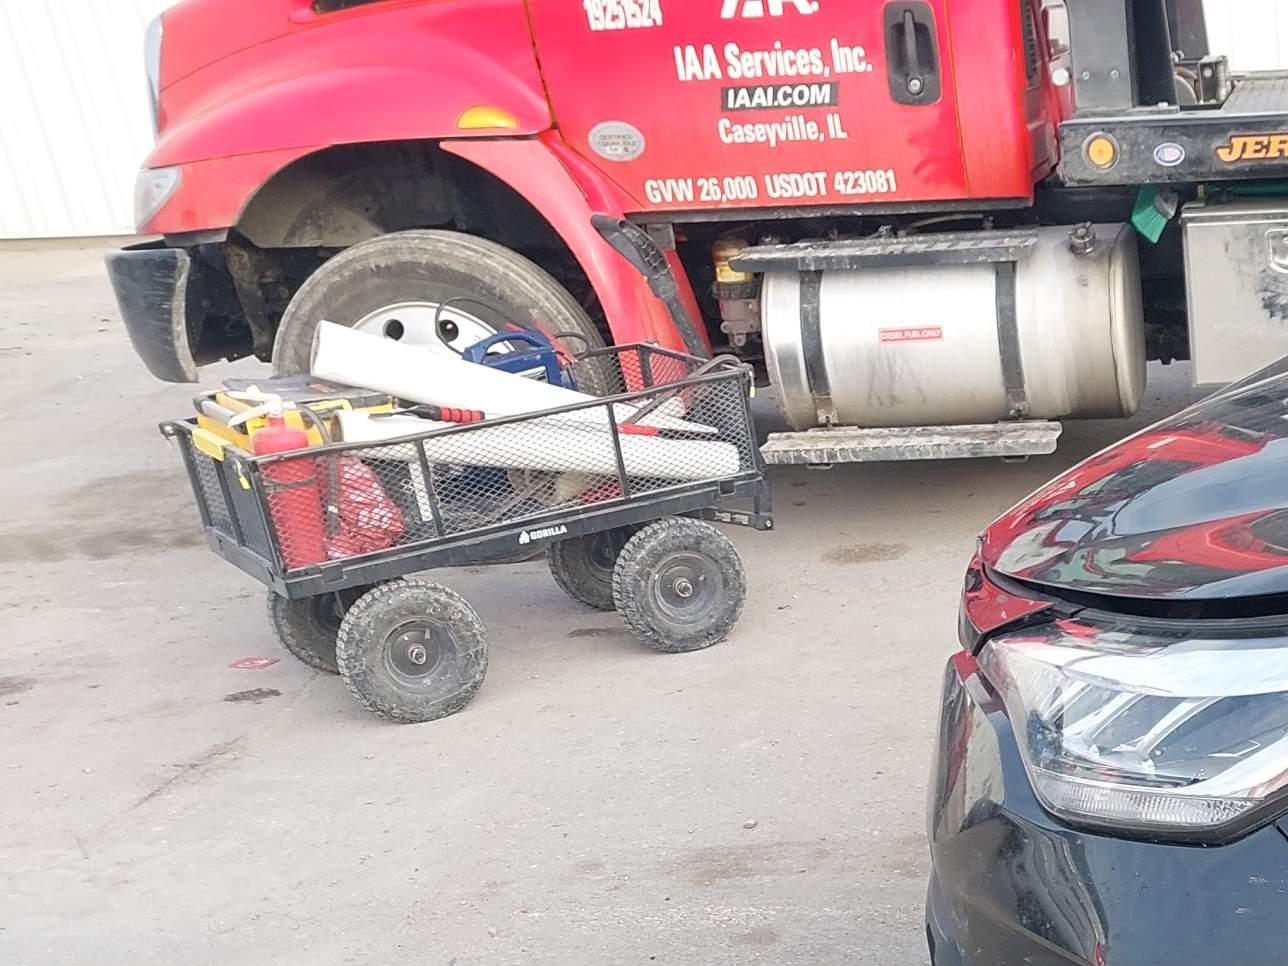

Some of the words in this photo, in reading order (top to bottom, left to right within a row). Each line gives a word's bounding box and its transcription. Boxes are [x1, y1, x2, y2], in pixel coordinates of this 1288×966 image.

[674, 44, 722, 81] IAA
[723, 41, 830, 79] Services,
[830, 38, 873, 73] Inc.
[727, 83, 831, 108] IAAI.COM
[718, 116, 825, 147] Caseyville,
[827, 113, 848, 140] IL
[645, 179, 695, 204] GVW
[697, 175, 758, 202] 26,000
[764, 172, 828, 198] USDOT
[834, 169, 897, 194] 423081
[530, 525, 568, 540] GORILLA
